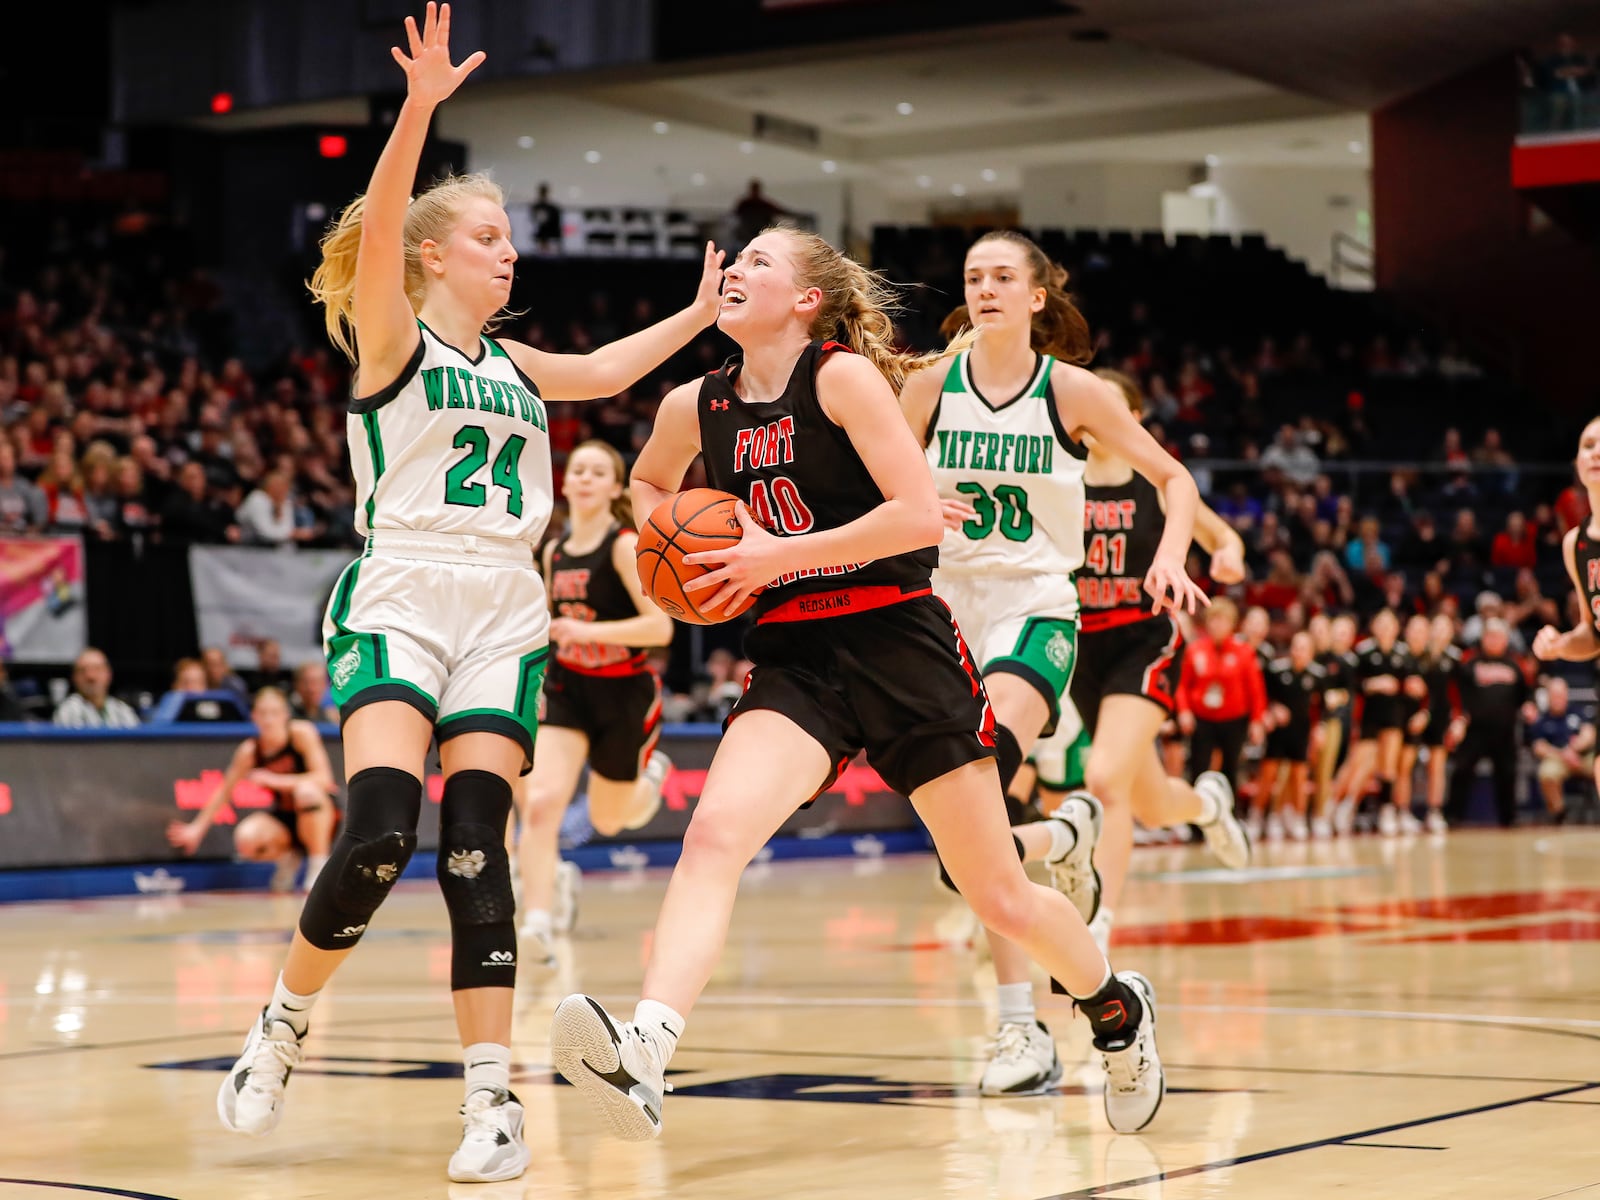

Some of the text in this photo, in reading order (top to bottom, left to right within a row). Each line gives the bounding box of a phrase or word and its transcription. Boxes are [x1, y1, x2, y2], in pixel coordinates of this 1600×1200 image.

[444, 424, 527, 520] 24
[734, 415, 795, 473] FORT
[955, 481, 1034, 543] 30
[1085, 532, 1127, 575] 41
[799, 593, 851, 613] REDSKINS
